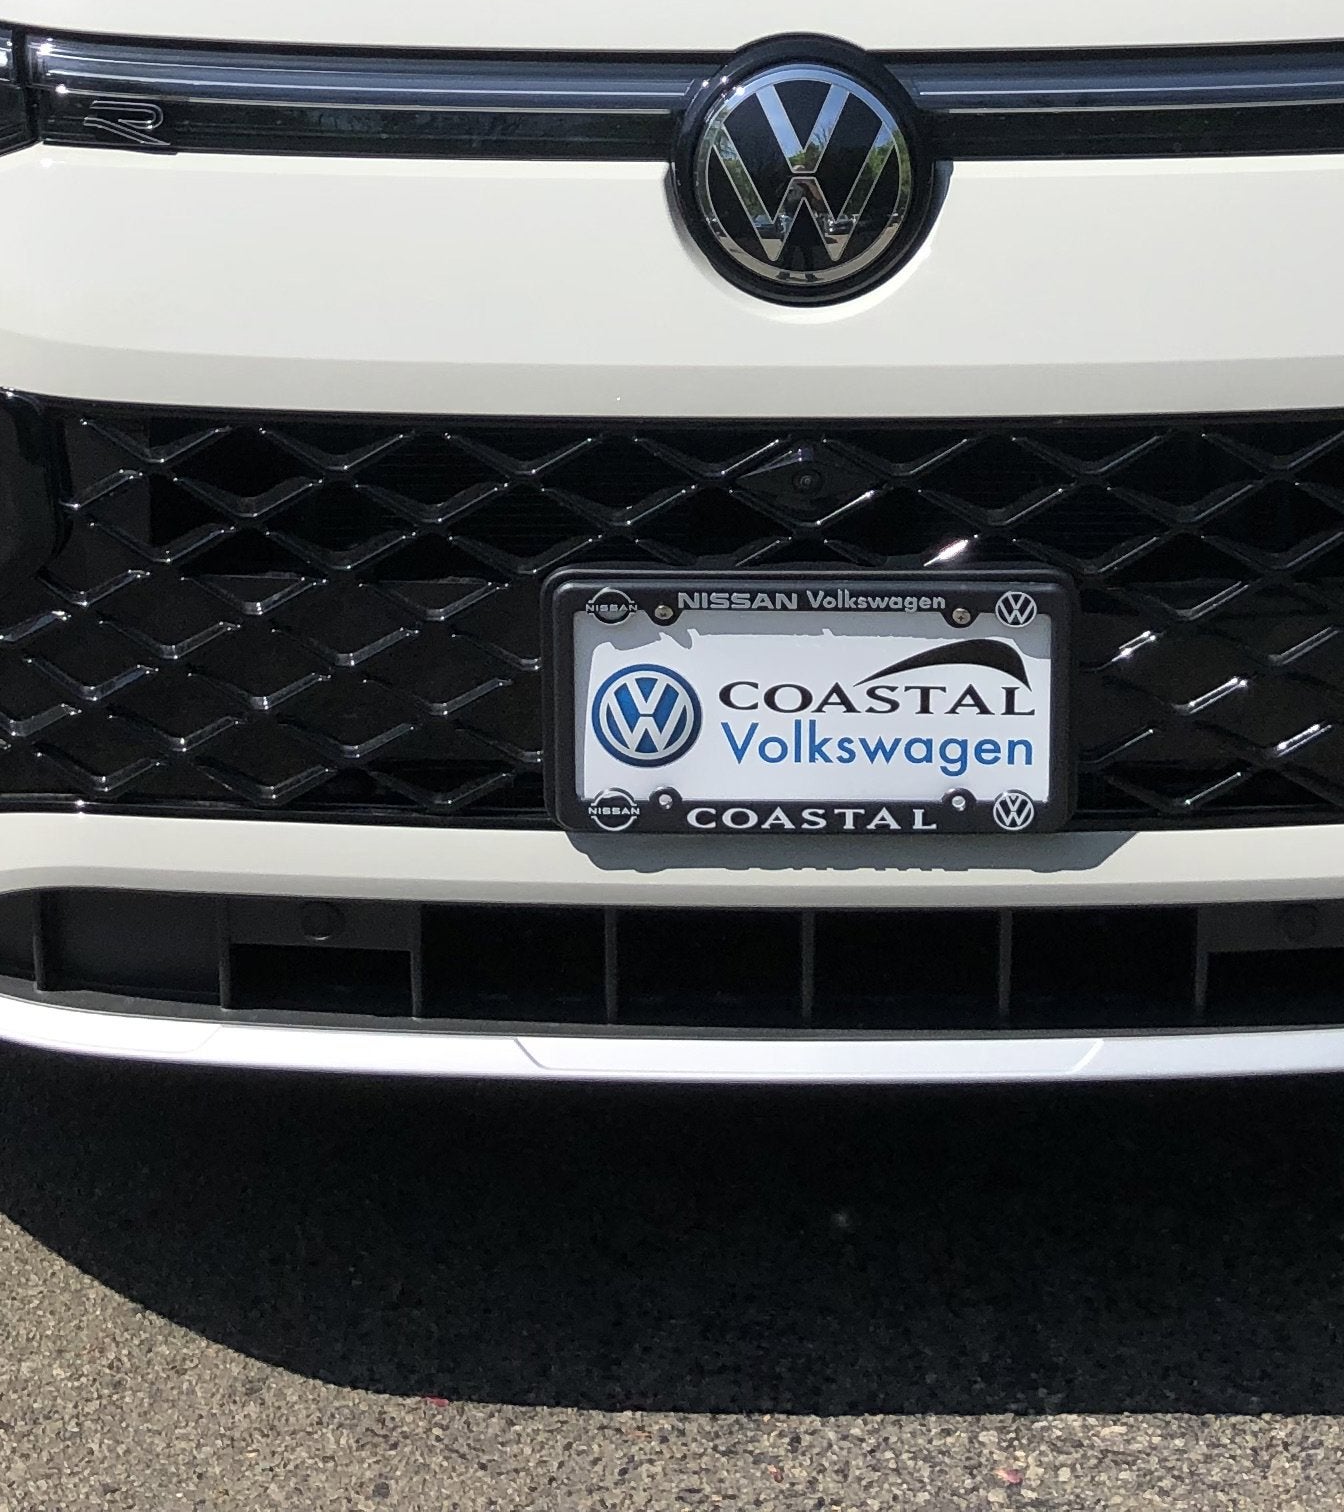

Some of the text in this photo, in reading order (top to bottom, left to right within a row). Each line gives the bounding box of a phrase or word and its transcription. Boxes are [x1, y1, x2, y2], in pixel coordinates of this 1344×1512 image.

[585, 603, 639, 614] NISSAN
[678, 589, 946, 613] NISSAN Volkswagen
[719, 681, 1035, 716] COASTAL
[721, 719, 1033, 777] Volkswagen
[588, 805, 641, 816] NISSAN
[687, 807, 937, 831] COASTAL
